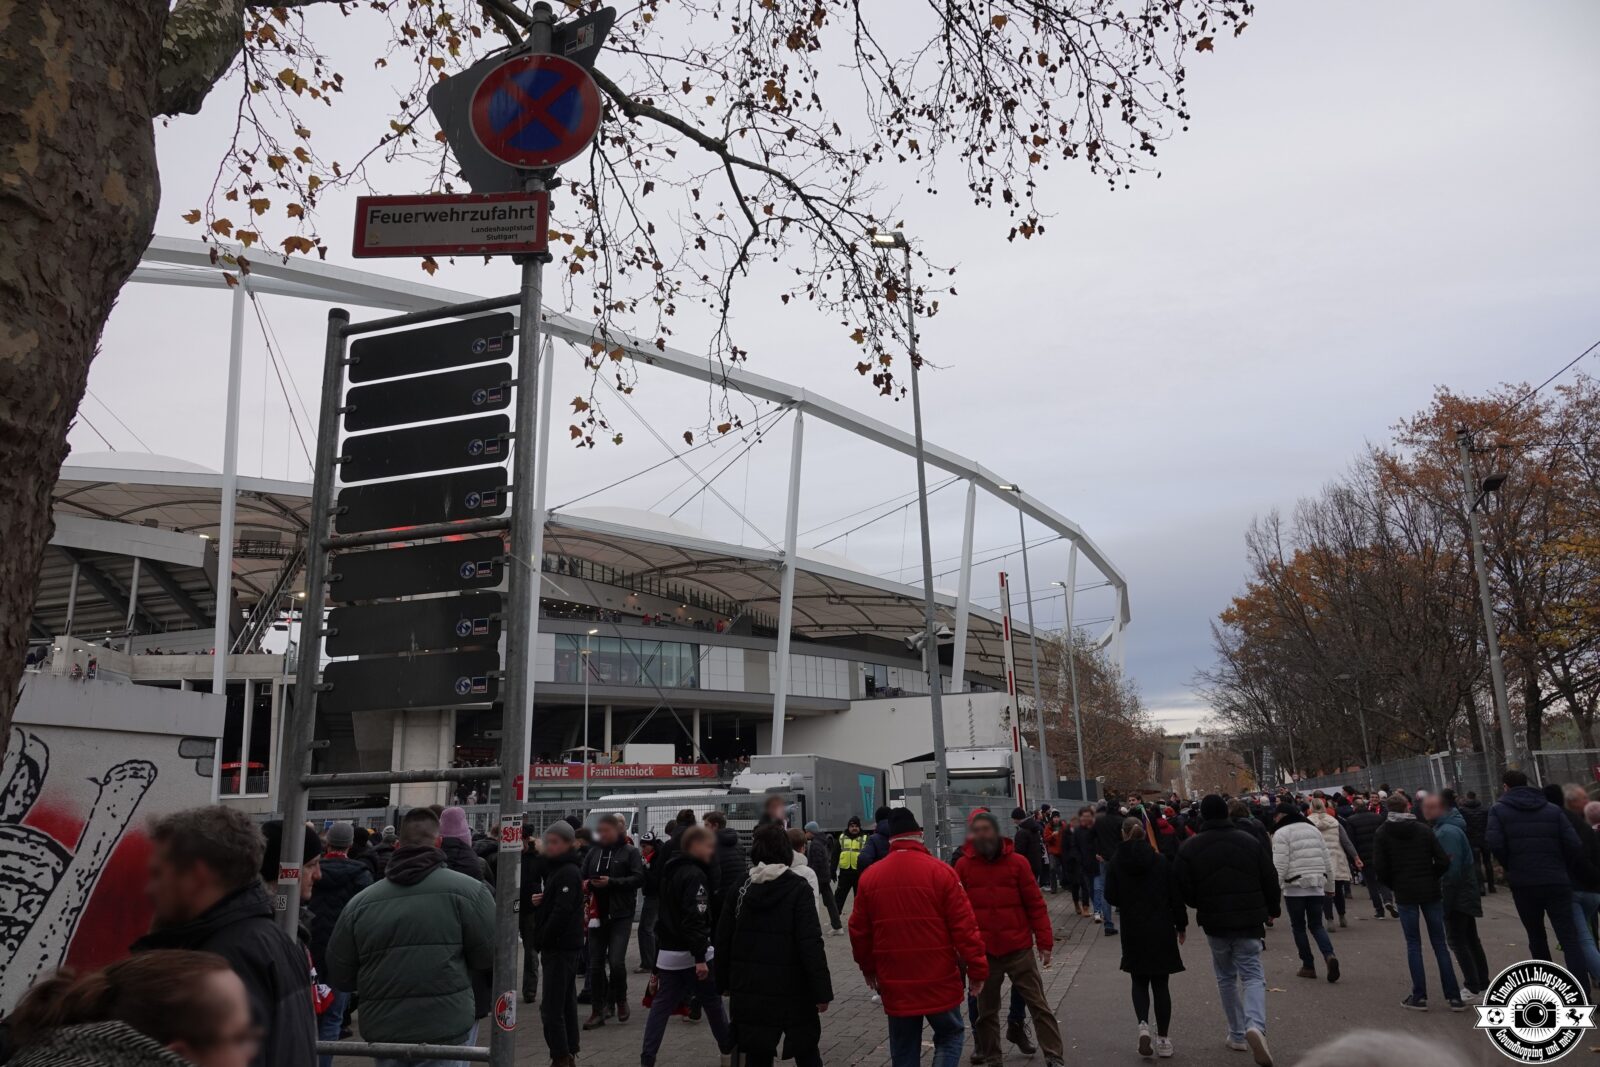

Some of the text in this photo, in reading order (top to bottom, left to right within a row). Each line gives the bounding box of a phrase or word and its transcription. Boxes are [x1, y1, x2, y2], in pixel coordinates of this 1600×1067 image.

[369, 205, 535, 224] Feuerwehrzufahrt
[472, 225, 534, 234] Landeshauptstadt
[487, 233, 518, 241] Stuttgart
[536, 765, 700, 777] REWE Familienblock REWE
